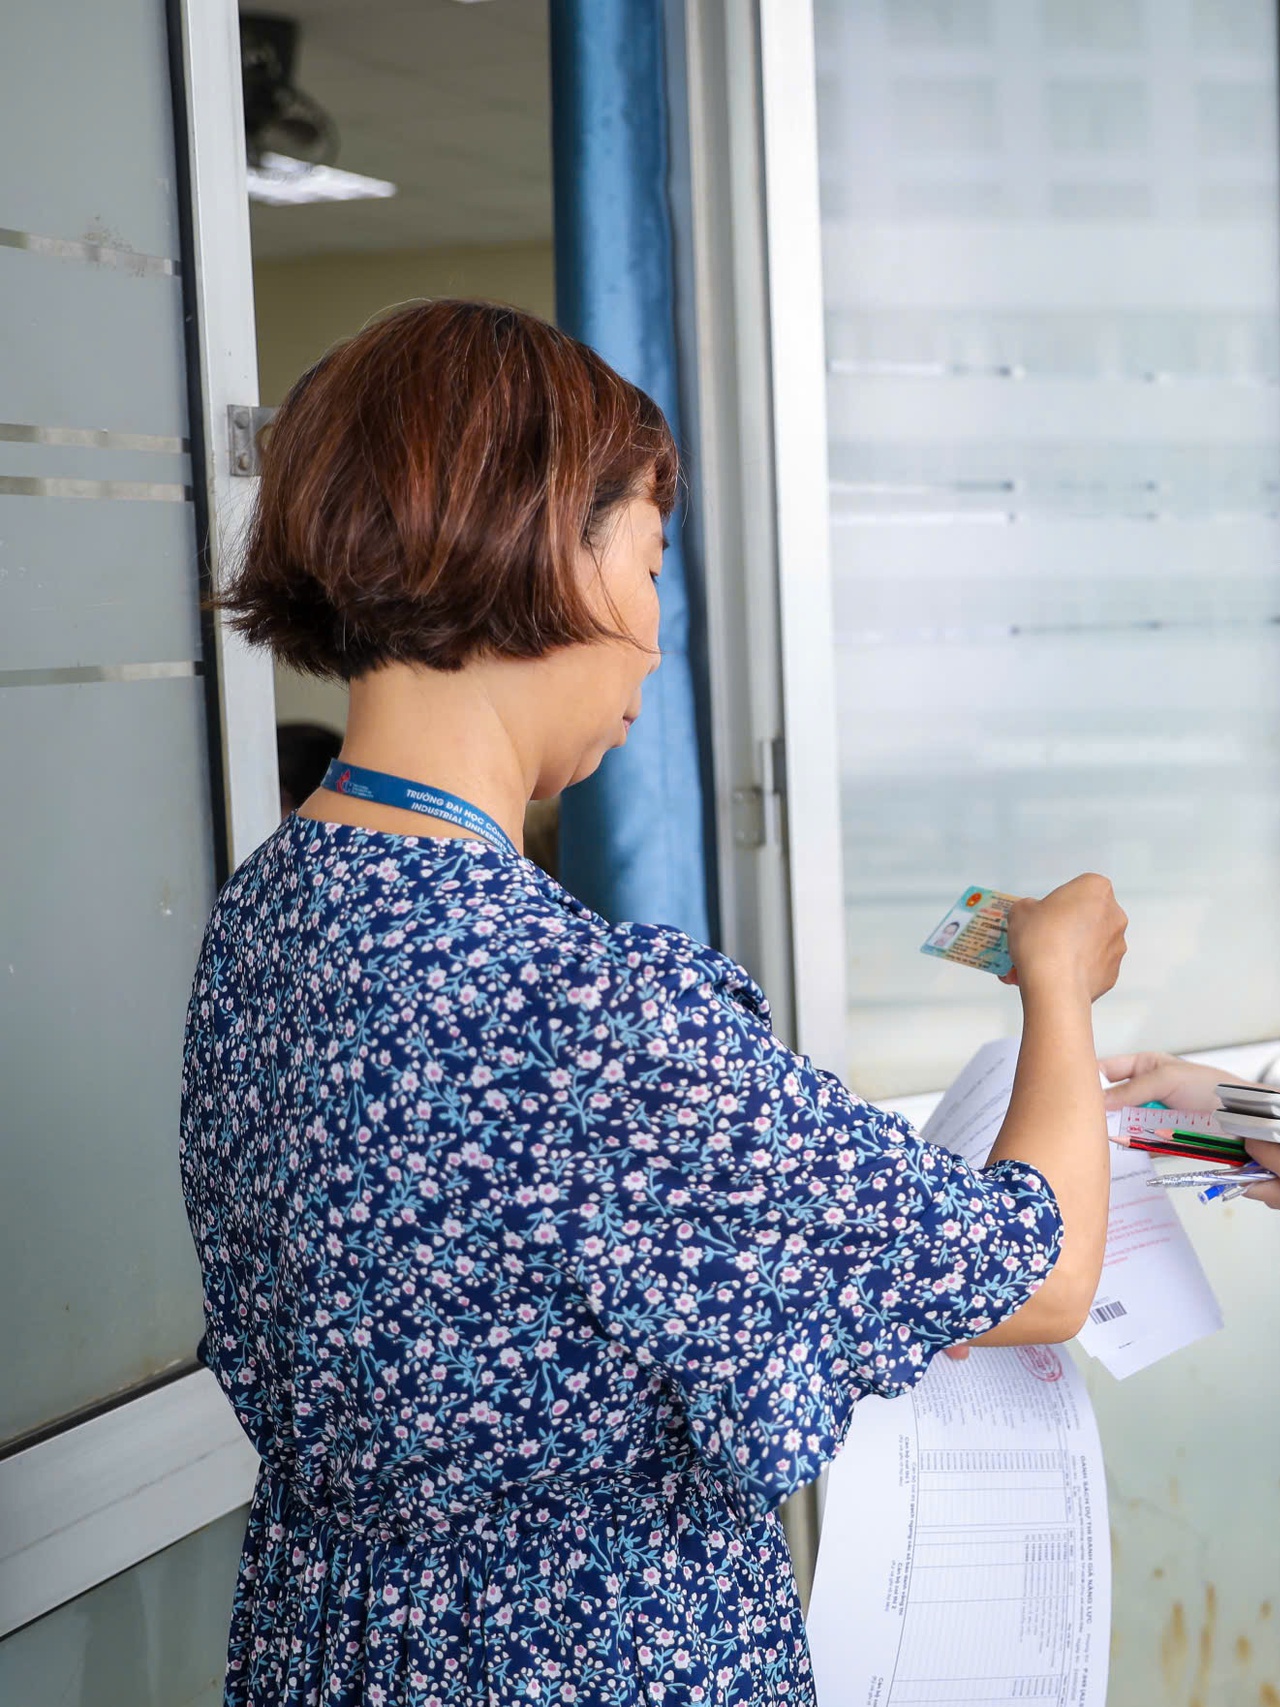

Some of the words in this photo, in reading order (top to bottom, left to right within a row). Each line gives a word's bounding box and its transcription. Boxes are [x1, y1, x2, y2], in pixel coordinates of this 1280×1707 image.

[406, 788, 444, 806] TRƯỜNG
[446, 801, 463, 814] ĐẠI
[464, 808, 484, 825] HỌC
[411, 802, 462, 825] INDUSTRIAL
